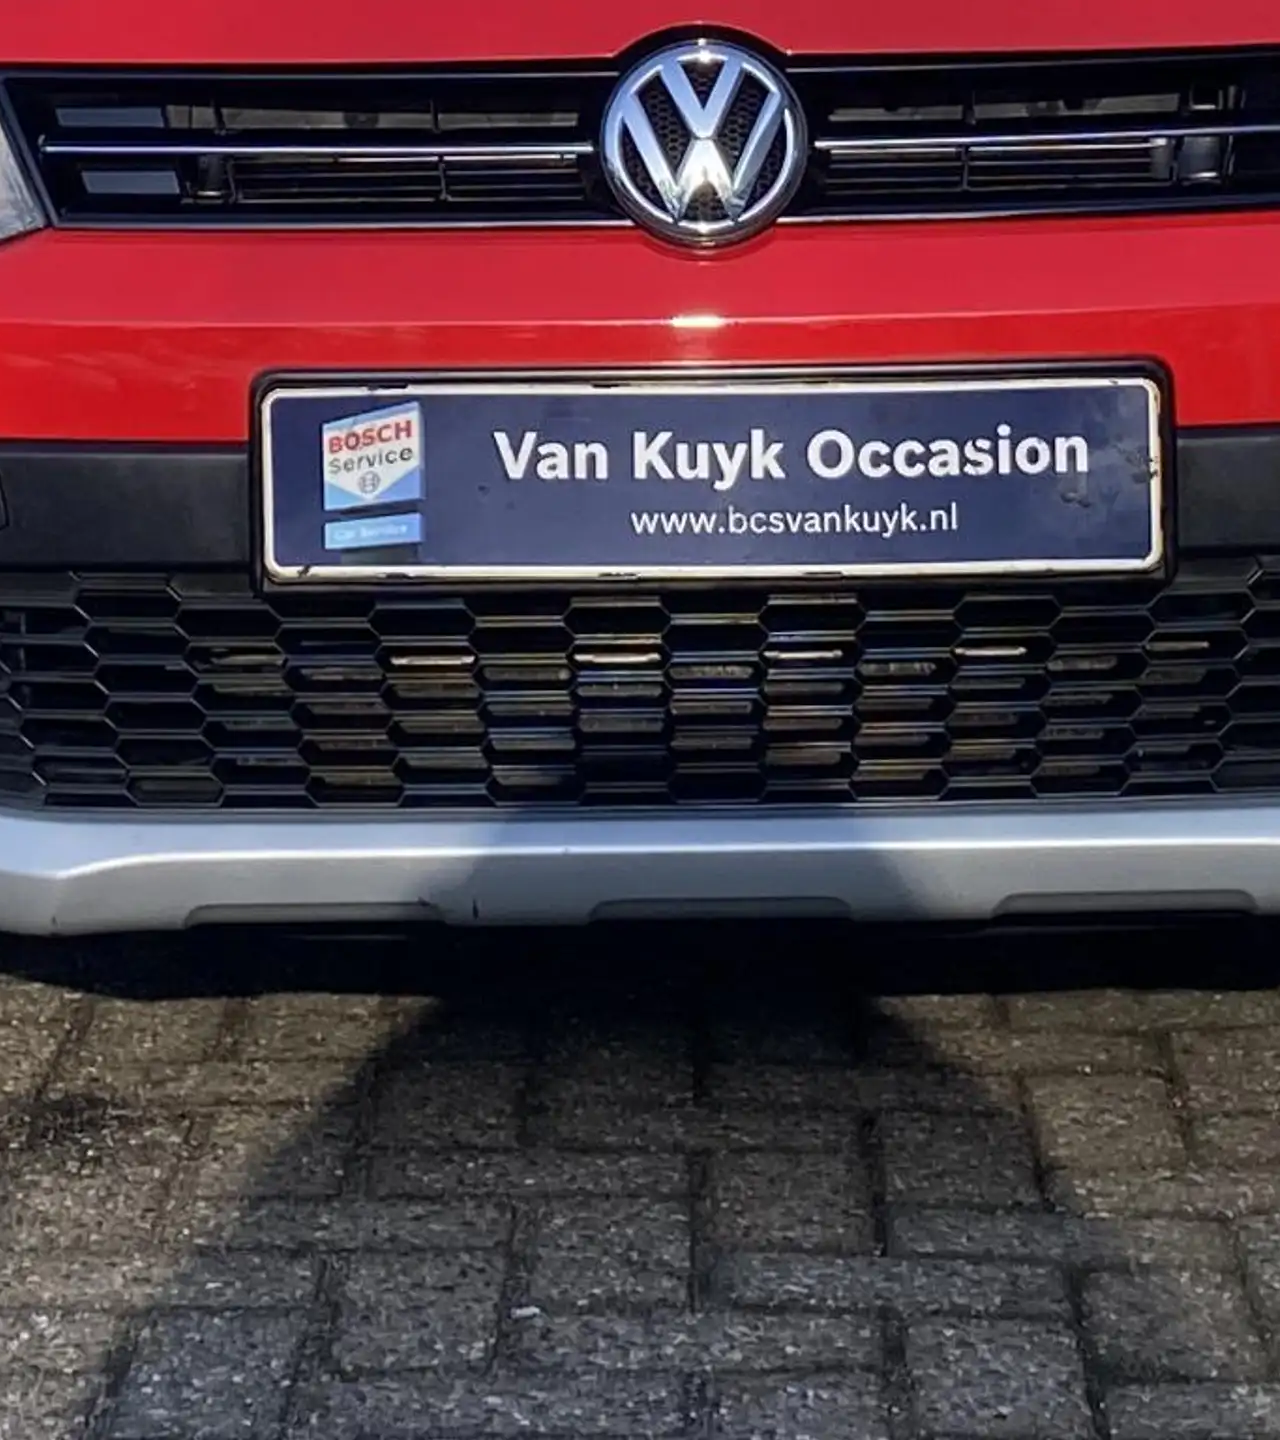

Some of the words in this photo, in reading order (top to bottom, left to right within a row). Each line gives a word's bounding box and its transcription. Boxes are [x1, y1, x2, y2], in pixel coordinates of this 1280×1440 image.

[328, 419, 413, 455] BOSCH
[328, 446, 414, 475] Service
[493, 430, 609, 480] Van
[632, 428, 786, 491] Kuyk
[806, 423, 1090, 479] Occasion
[630, 501, 959, 538] www.bcsvankuyk.nl
